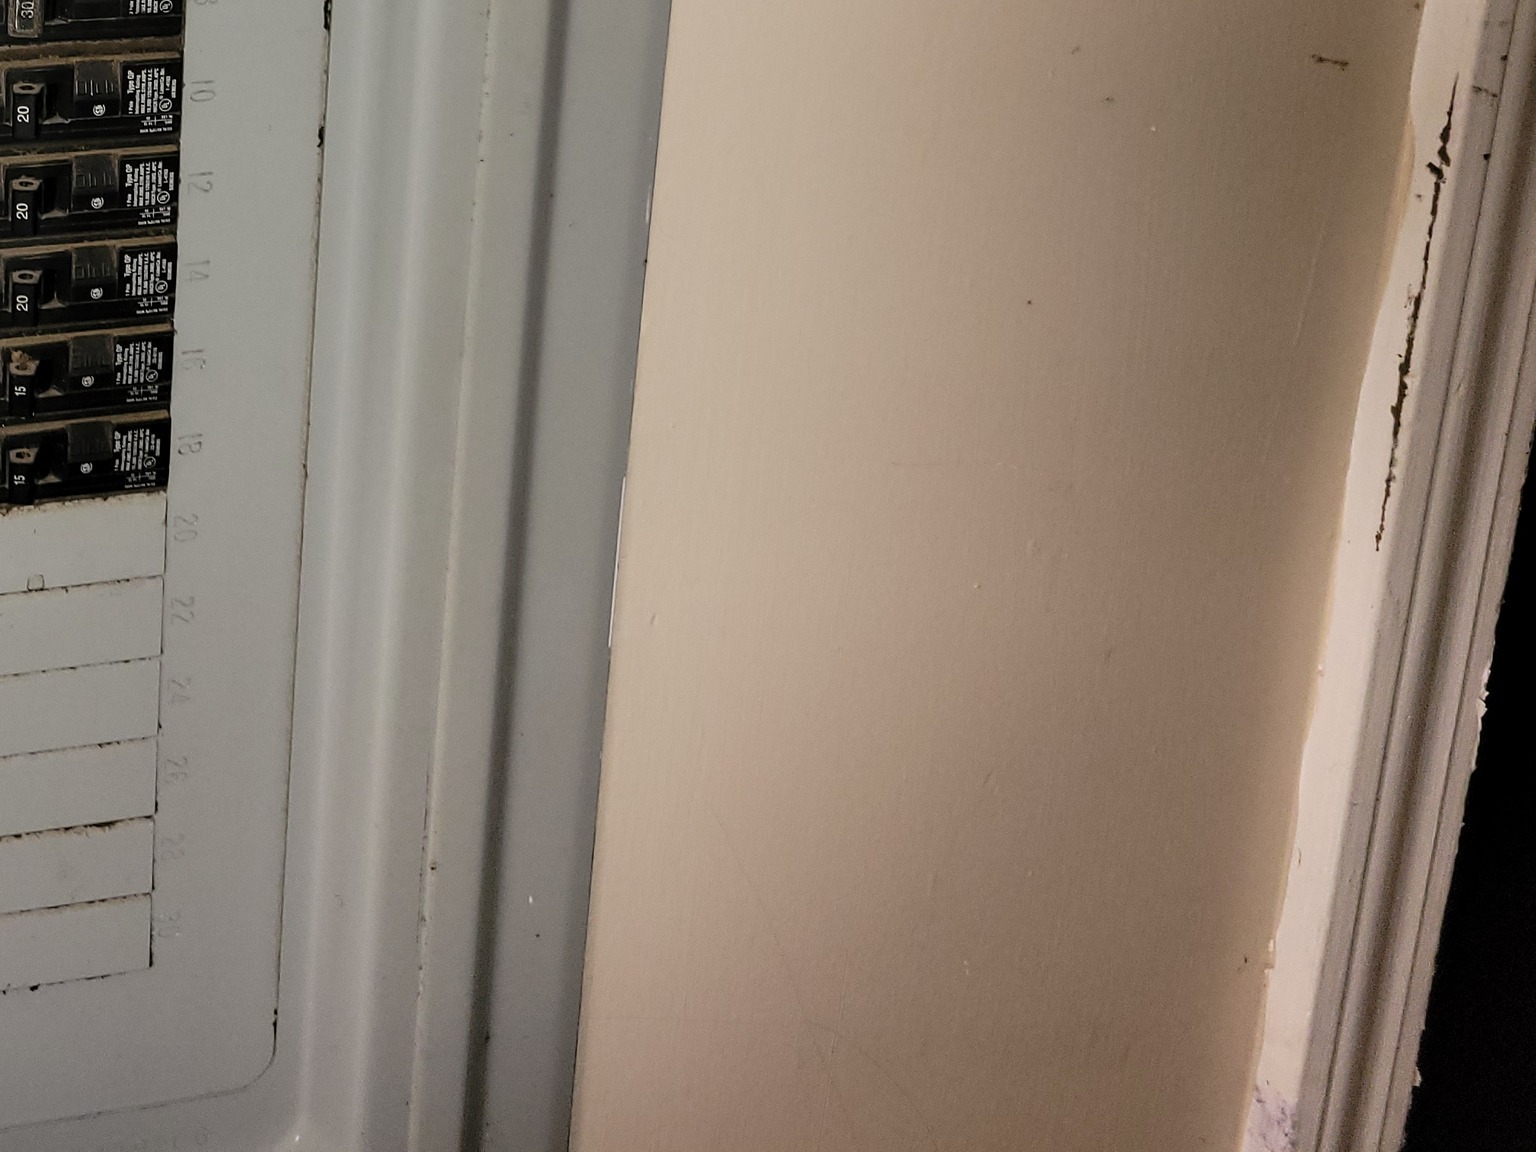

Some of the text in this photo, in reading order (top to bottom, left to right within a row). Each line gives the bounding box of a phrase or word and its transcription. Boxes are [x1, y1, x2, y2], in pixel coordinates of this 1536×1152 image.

[20, 1, 34, 19] 30
[189, 80, 215, 103] 10
[17, 105, 29, 123] 20
[188, 171, 214, 194] 12
[16, 202, 28, 220] 20
[16, 295, 28, 312] 20
[15, 385, 26, 397] 15
[177, 433, 203, 456] 18
[14, 474, 25, 485] 15
[174, 513, 199, 543] 20
[171, 597, 195, 624] 22
